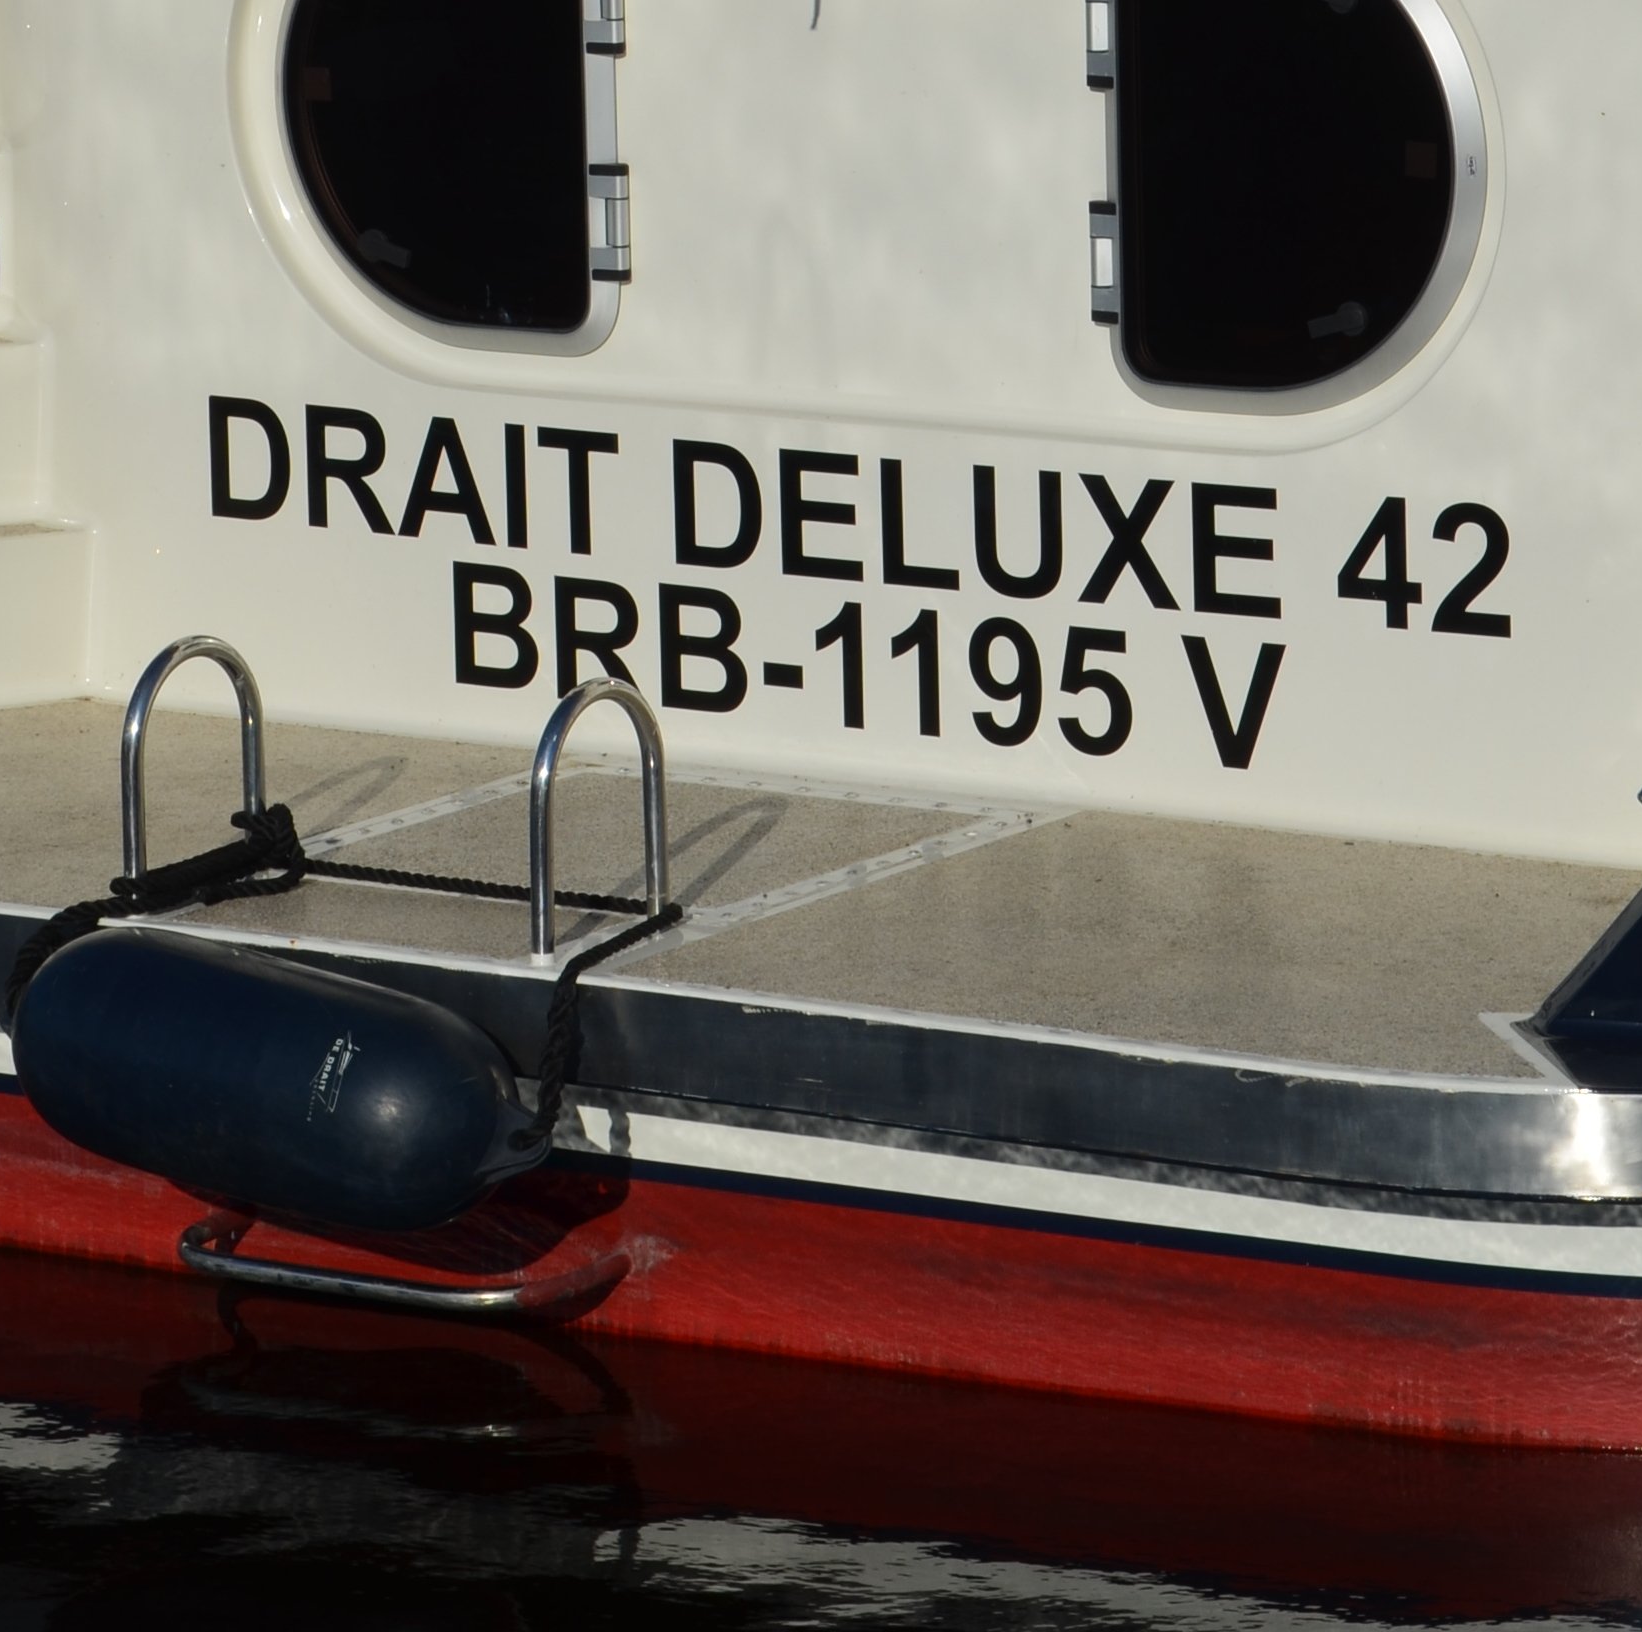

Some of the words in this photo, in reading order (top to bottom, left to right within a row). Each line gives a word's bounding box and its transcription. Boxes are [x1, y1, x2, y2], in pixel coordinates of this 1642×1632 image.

[208, 394, 619, 556] DRAIT
[672, 439, 1282, 619] DELUXE
[1337, 497, 1512, 638] 42
[453, 561, 1133, 757] BRB-1195
[1181, 636, 1286, 769] V
[318, 1056, 335, 1092] DRAIT
